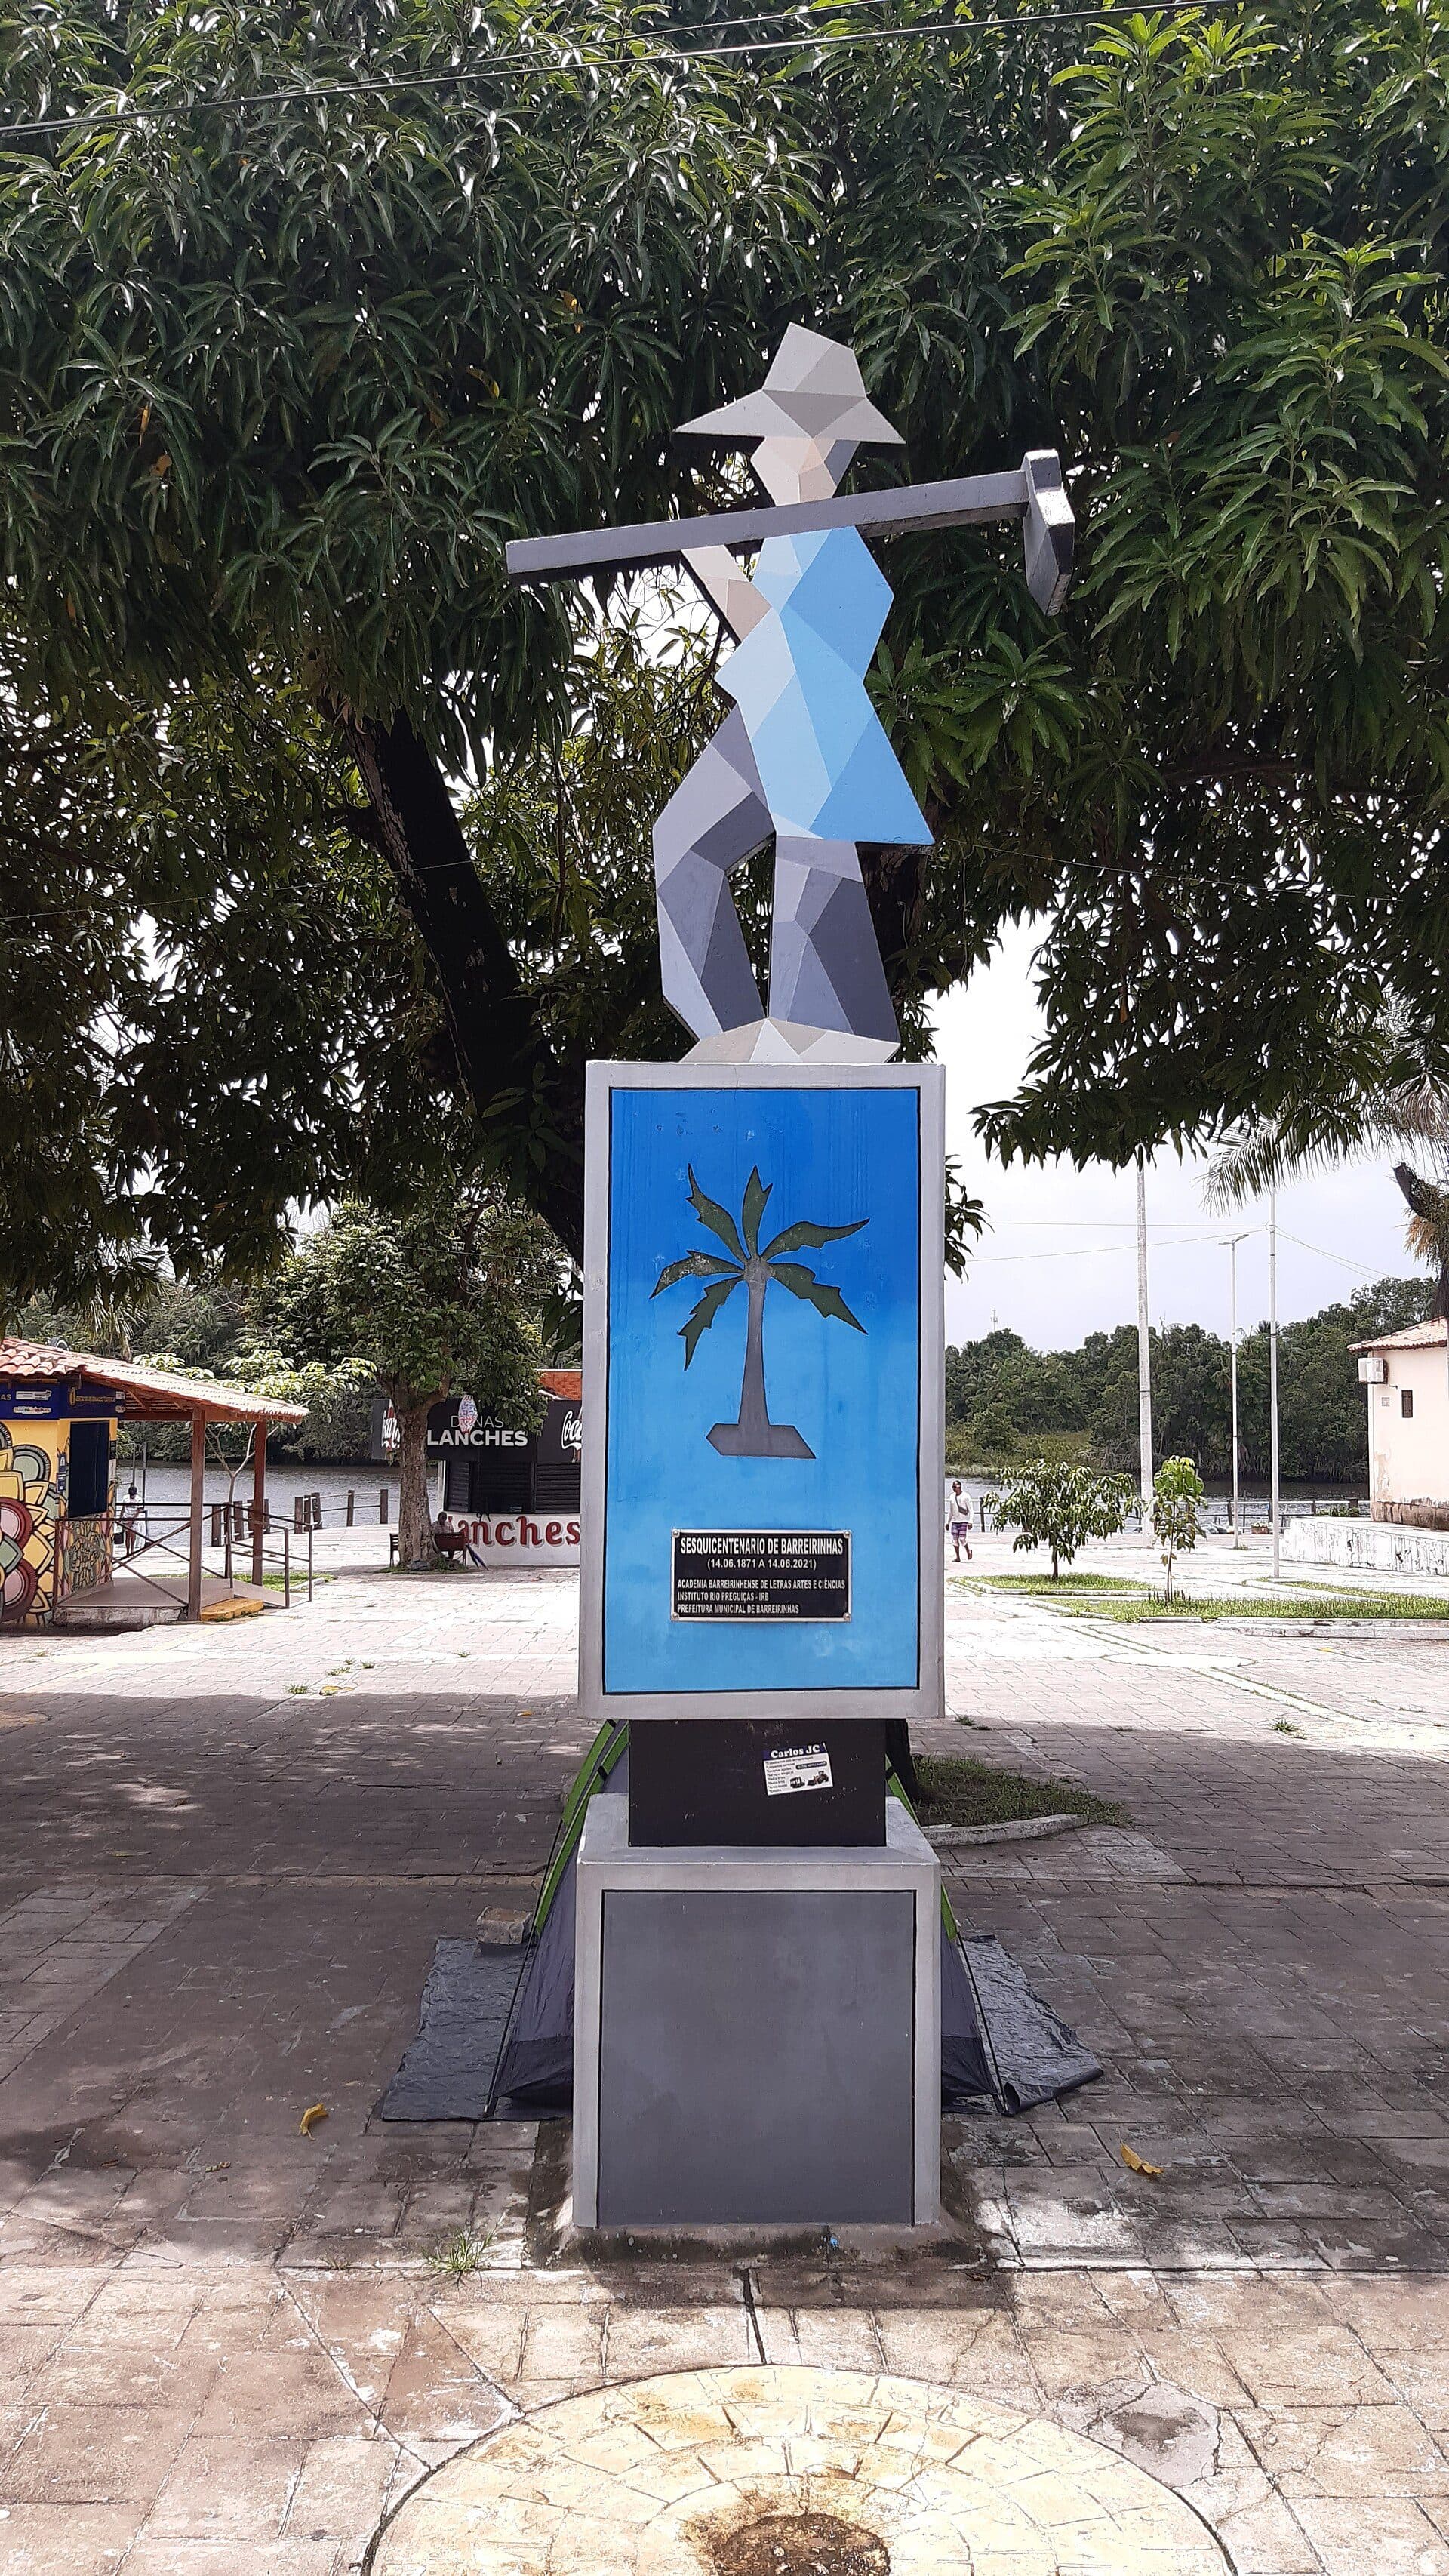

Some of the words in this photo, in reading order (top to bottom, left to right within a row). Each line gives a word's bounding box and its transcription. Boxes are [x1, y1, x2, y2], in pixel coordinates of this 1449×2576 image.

[451, 1415, 504, 1428] DNAS
[427, 1430, 528, 1447] LANCHES
[681, 1537, 764, 1555] SESQUICENTENARIO
[768, 1538, 778, 1555] DE
[781, 1538, 843, 1555] BARREIRINHAS
[707, 1559, 755, 1570] (14.06.1871
[758, 1559, 765, 1568] A
[768, 1559, 817, 1570] 14.06.2021)
[678, 1579, 707, 1589] ACADEMIA
[709, 1579, 759, 1589] BARREIRINHENSE
[761, 1579, 768, 1589] DE
[770, 1579, 792, 1589] LETRAS
[793, 1579, 811, 1589] ARTES
[813, 1580, 817, 1589] E
[818, 1577, 845, 1589] CIÊNCIAS
[678, 1592, 709, 1601] INSTITUTO
[709, 1592, 720, 1601] RIO
[721, 1592, 755, 1603] PREGUIÇAS
[759, 1592, 769, 1601] IRB
[677, 1604, 713, 1613] PREFEITURA
[714, 1604, 746, 1613] MUNICIPAL
[747, 1604, 755, 1614] DE
[756, 1604, 799, 1614] BARREIRINHAS
[771, 1748, 804, 1758] Carlos
[806, 1744, 820, 1754] JC
